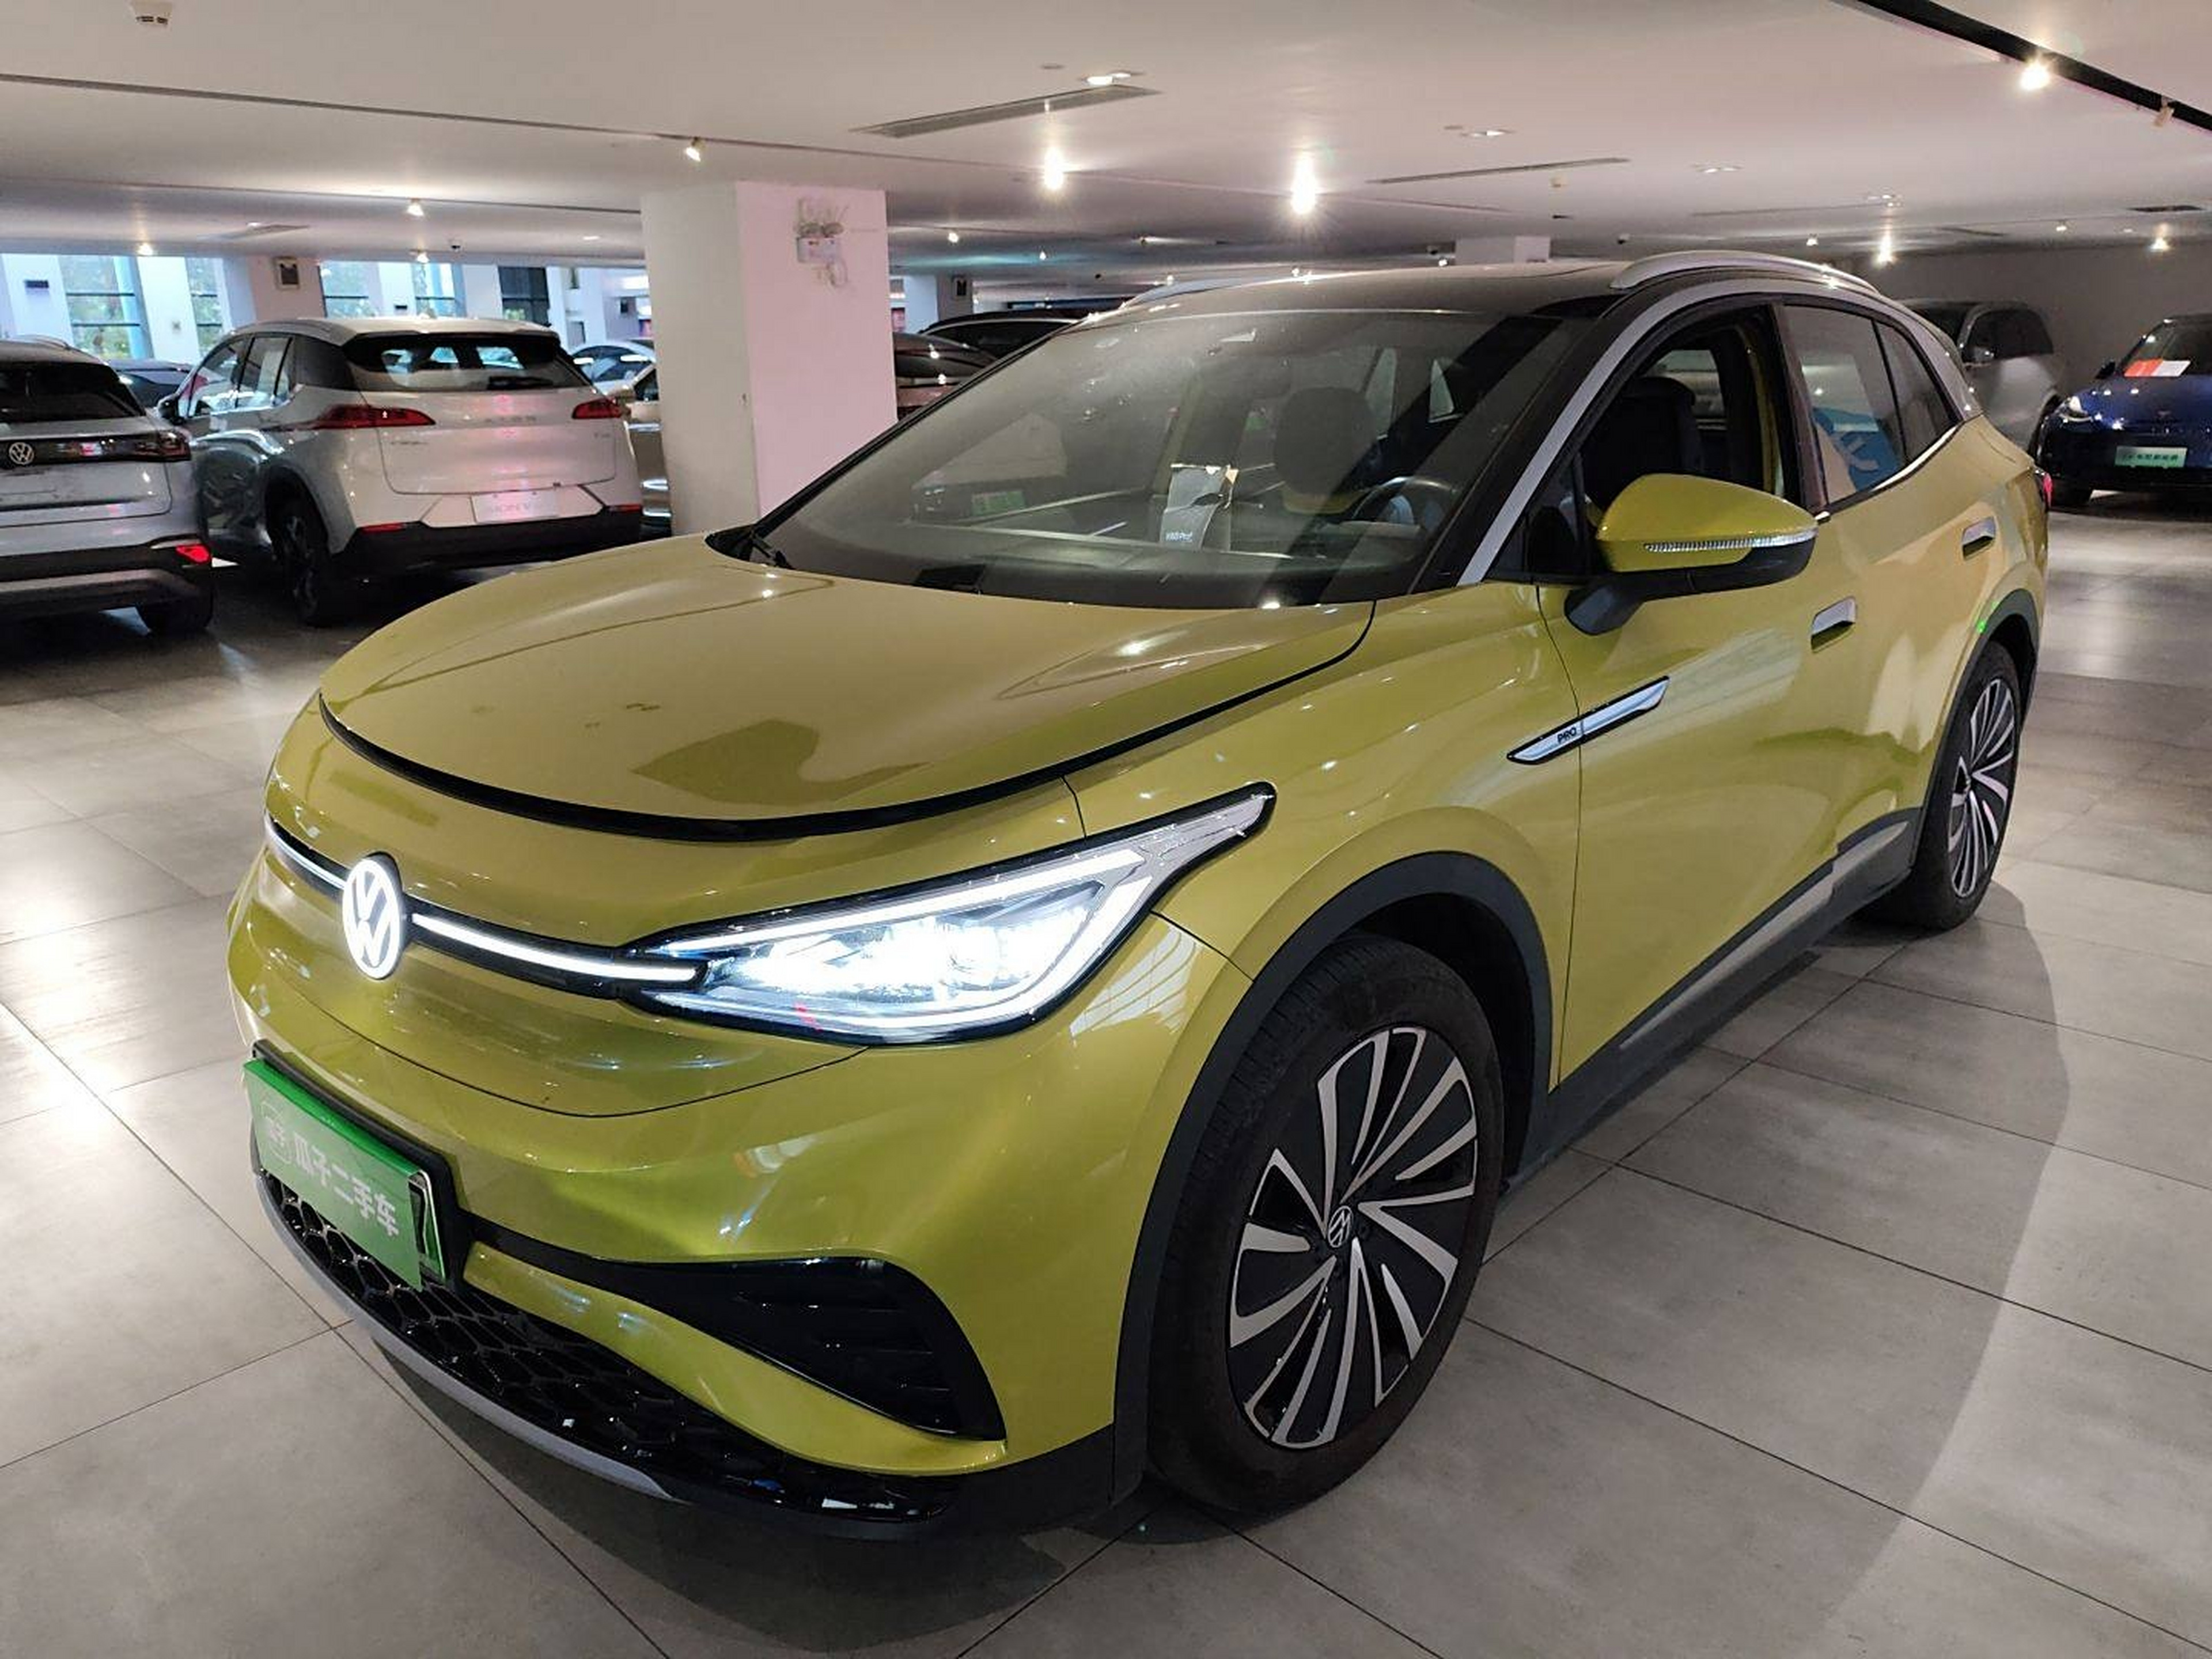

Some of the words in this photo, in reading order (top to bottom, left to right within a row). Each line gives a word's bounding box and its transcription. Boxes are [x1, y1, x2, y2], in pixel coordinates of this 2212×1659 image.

[1557, 726, 1577, 744] PRO
[343, 859, 400, 978] VW
[294, 1131, 399, 1237] 瓜子二手车
